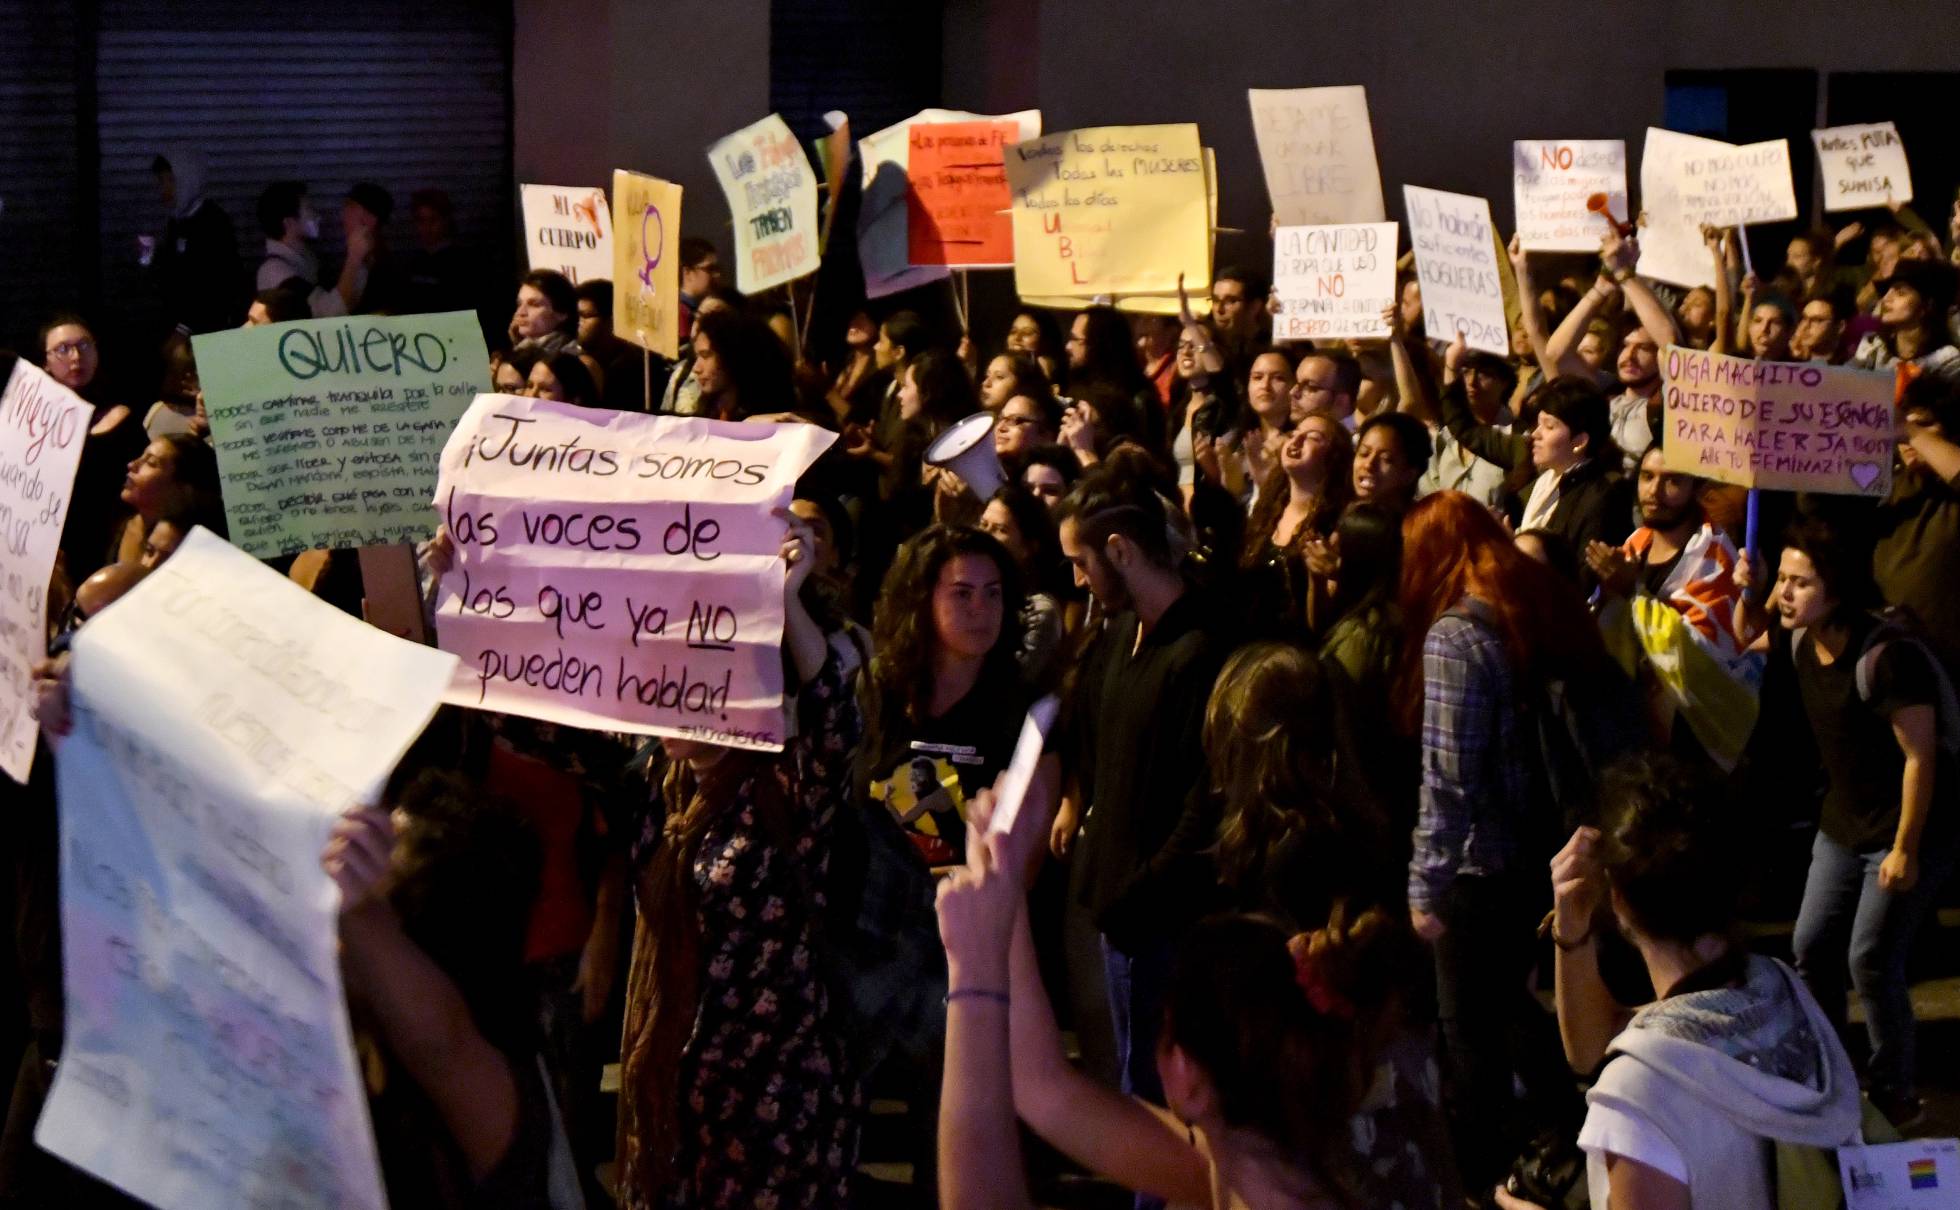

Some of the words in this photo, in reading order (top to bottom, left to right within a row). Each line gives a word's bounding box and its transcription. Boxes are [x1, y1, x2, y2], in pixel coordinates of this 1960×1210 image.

[1074, 133, 1094, 153] los
[1100, 138, 1160, 153] derechos
[1860, 130, 1899, 150] PUTA
[1134, 157, 1200, 176] MUJERES
[1541, 145, 1573, 171] NO
[1845, 152, 1875, 173] que
[1838, 175, 1893, 194] SUMISA
[553, 194, 569, 216] MI
[539, 226, 596, 249] CUERPO
[1306, 227, 1377, 254] CANTIDAD
[1318, 273, 1344, 298] NO
[1419, 258, 1499, 299] HOGUERAS
[1427, 307, 1440, 333] A
[1445, 312, 1504, 346] TODAS
[1669, 350, 1710, 387] OIGA
[1715, 360, 1822, 387] MACHITO
[1668, 385, 1735, 416] QUIERO
[1741, 400, 1774, 422] DE
[1780, 405, 1814, 424] SU
[1677, 419, 1724, 443] PARA
[1733, 429, 1809, 451] HACER
[464, 414, 619, 477] ¡Juntas
[638, 452, 769, 486] somos
[446, 486, 499, 546] las
[522, 511, 641, 550] voces
[662, 503, 721, 561] de
[459, 570, 515, 617] las
[538, 585, 605, 640] que
[626, 597, 669, 648] ya
[686, 600, 737, 649] NO
[478, 648, 602, 704] pueden
[616, 656, 733, 721] hablar!
